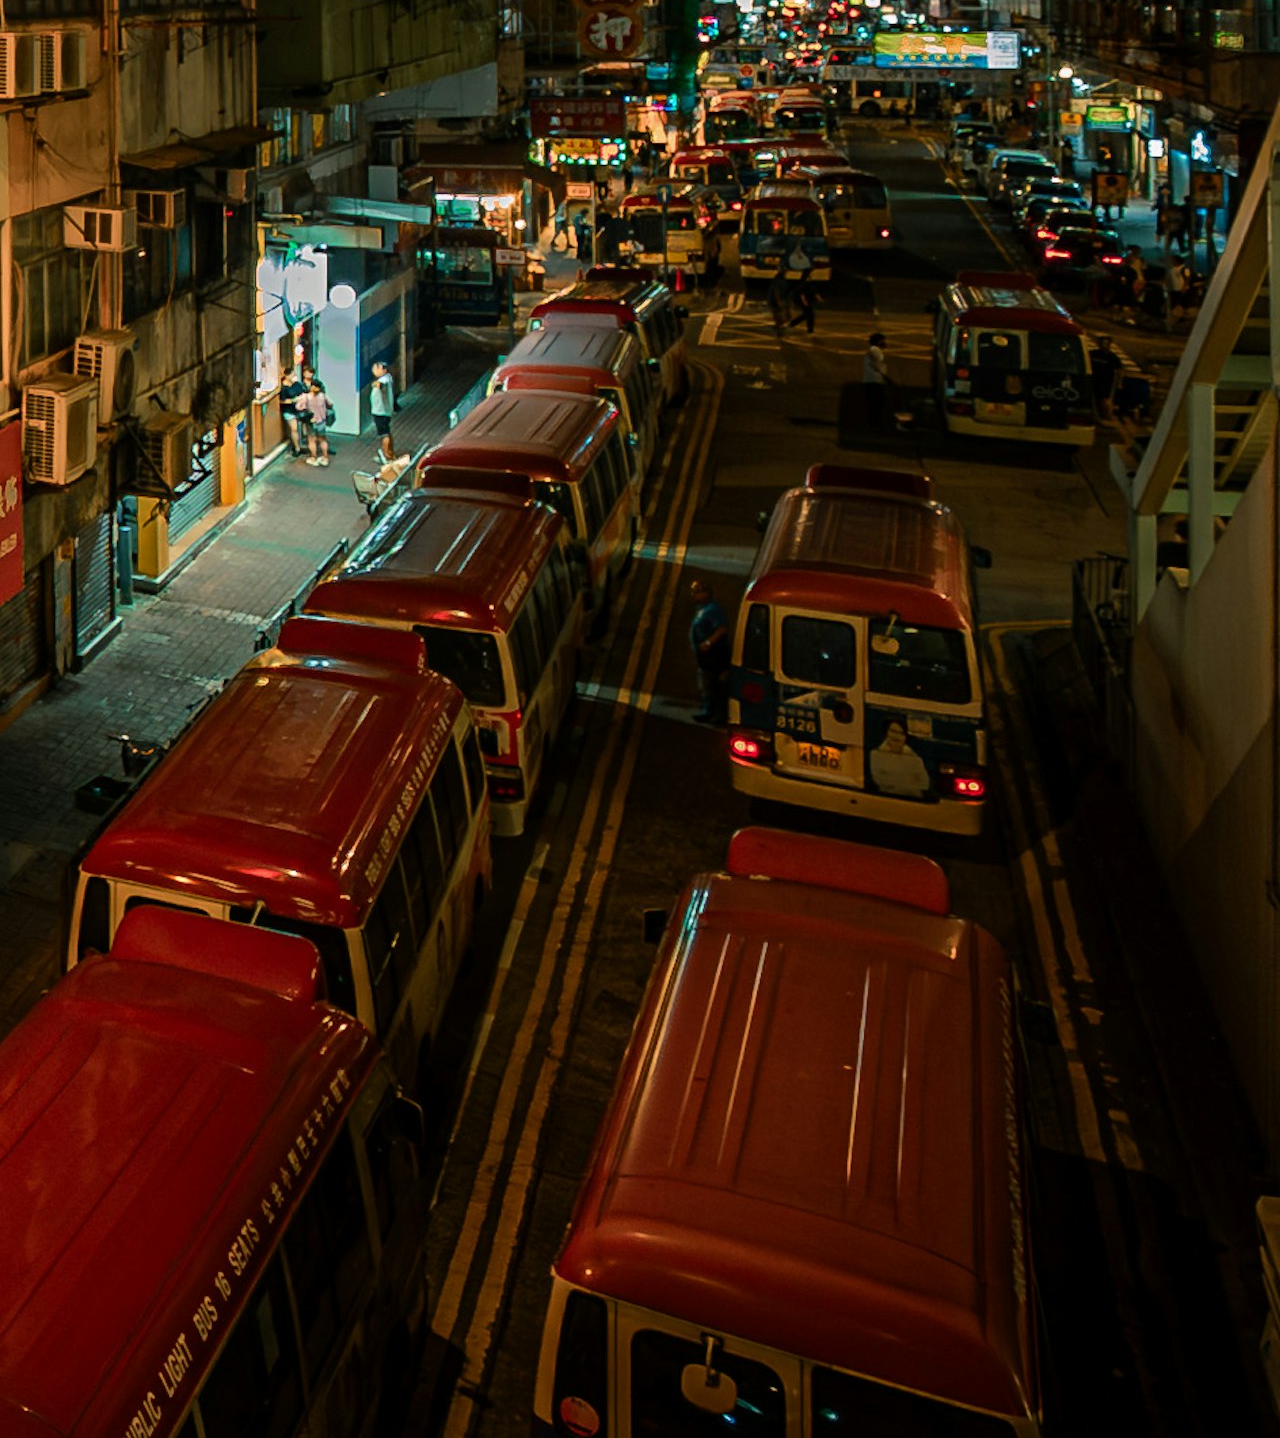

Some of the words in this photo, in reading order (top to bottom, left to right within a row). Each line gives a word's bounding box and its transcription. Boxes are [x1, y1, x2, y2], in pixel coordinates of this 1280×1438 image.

[158, 1332, 194, 1398] LIGHT
[193, 1295, 219, 1342] BUS
[215, 1270, 233, 1302] 16
[228, 1218, 261, 1276] SEATS
